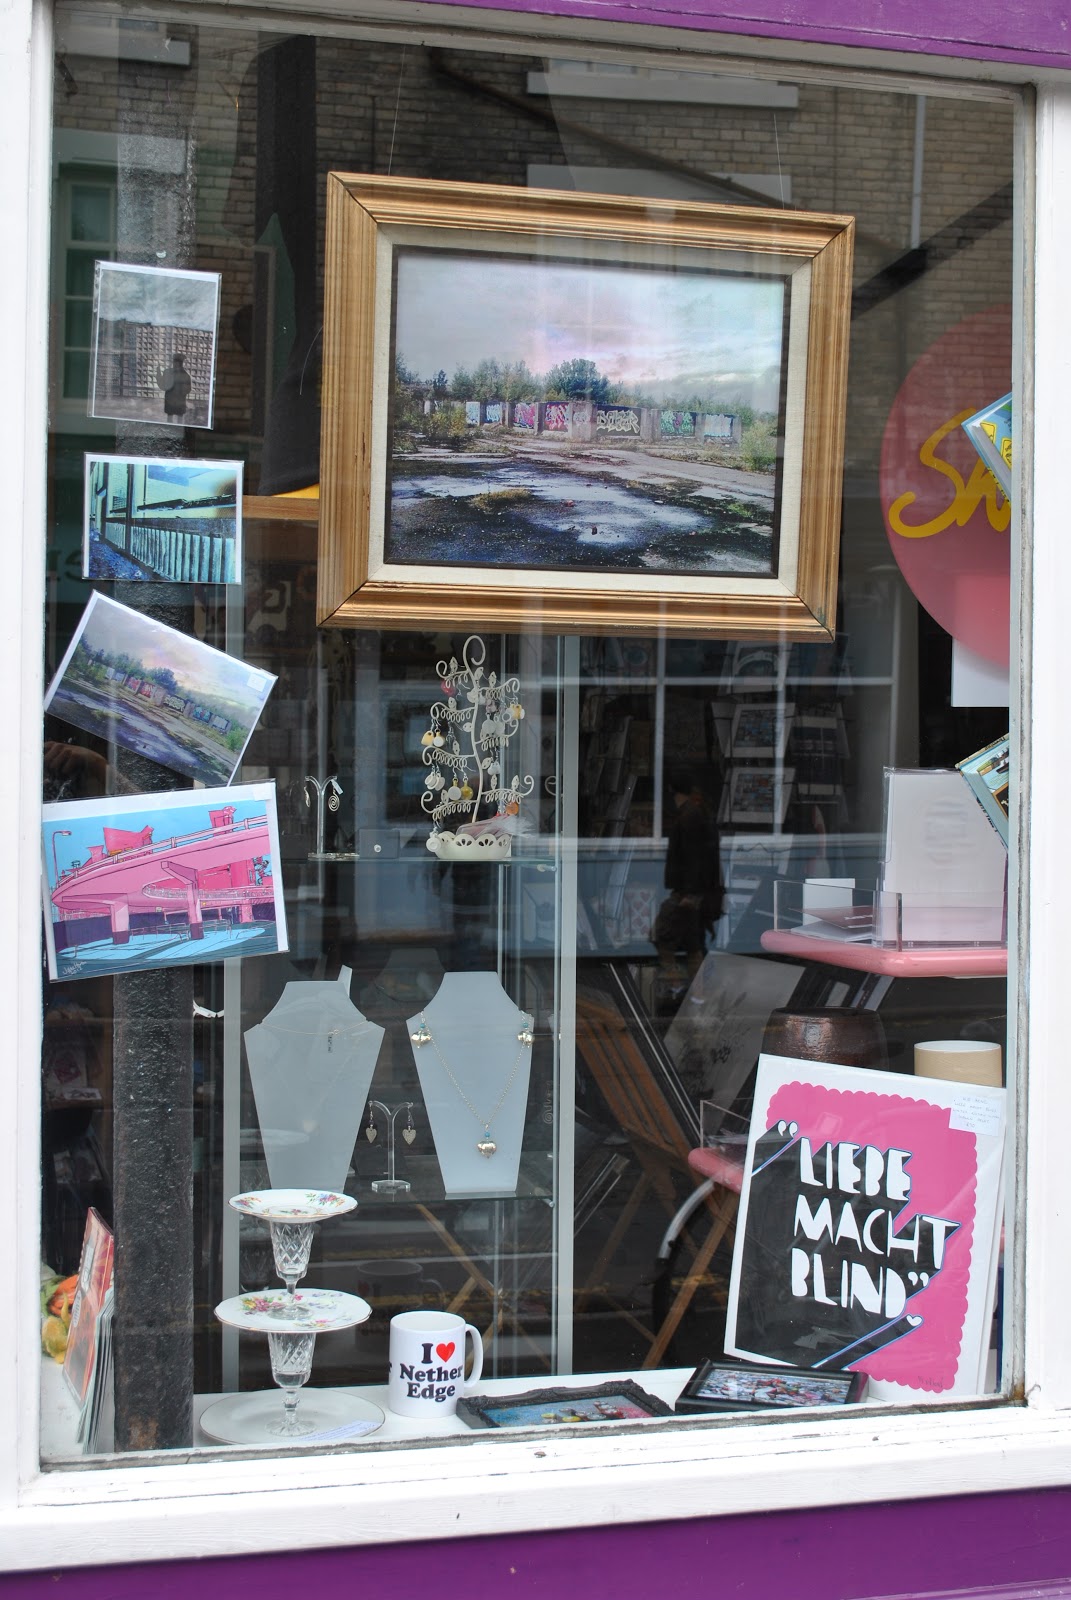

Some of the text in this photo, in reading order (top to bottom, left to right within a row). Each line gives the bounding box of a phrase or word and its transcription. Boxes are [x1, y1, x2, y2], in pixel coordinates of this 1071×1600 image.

[794, 1194, 960, 1269] MACHT
[421, 1342, 434, 1364] I
[400, 1363, 463, 1382] Nether
[406, 1381, 456, 1402] Edge
